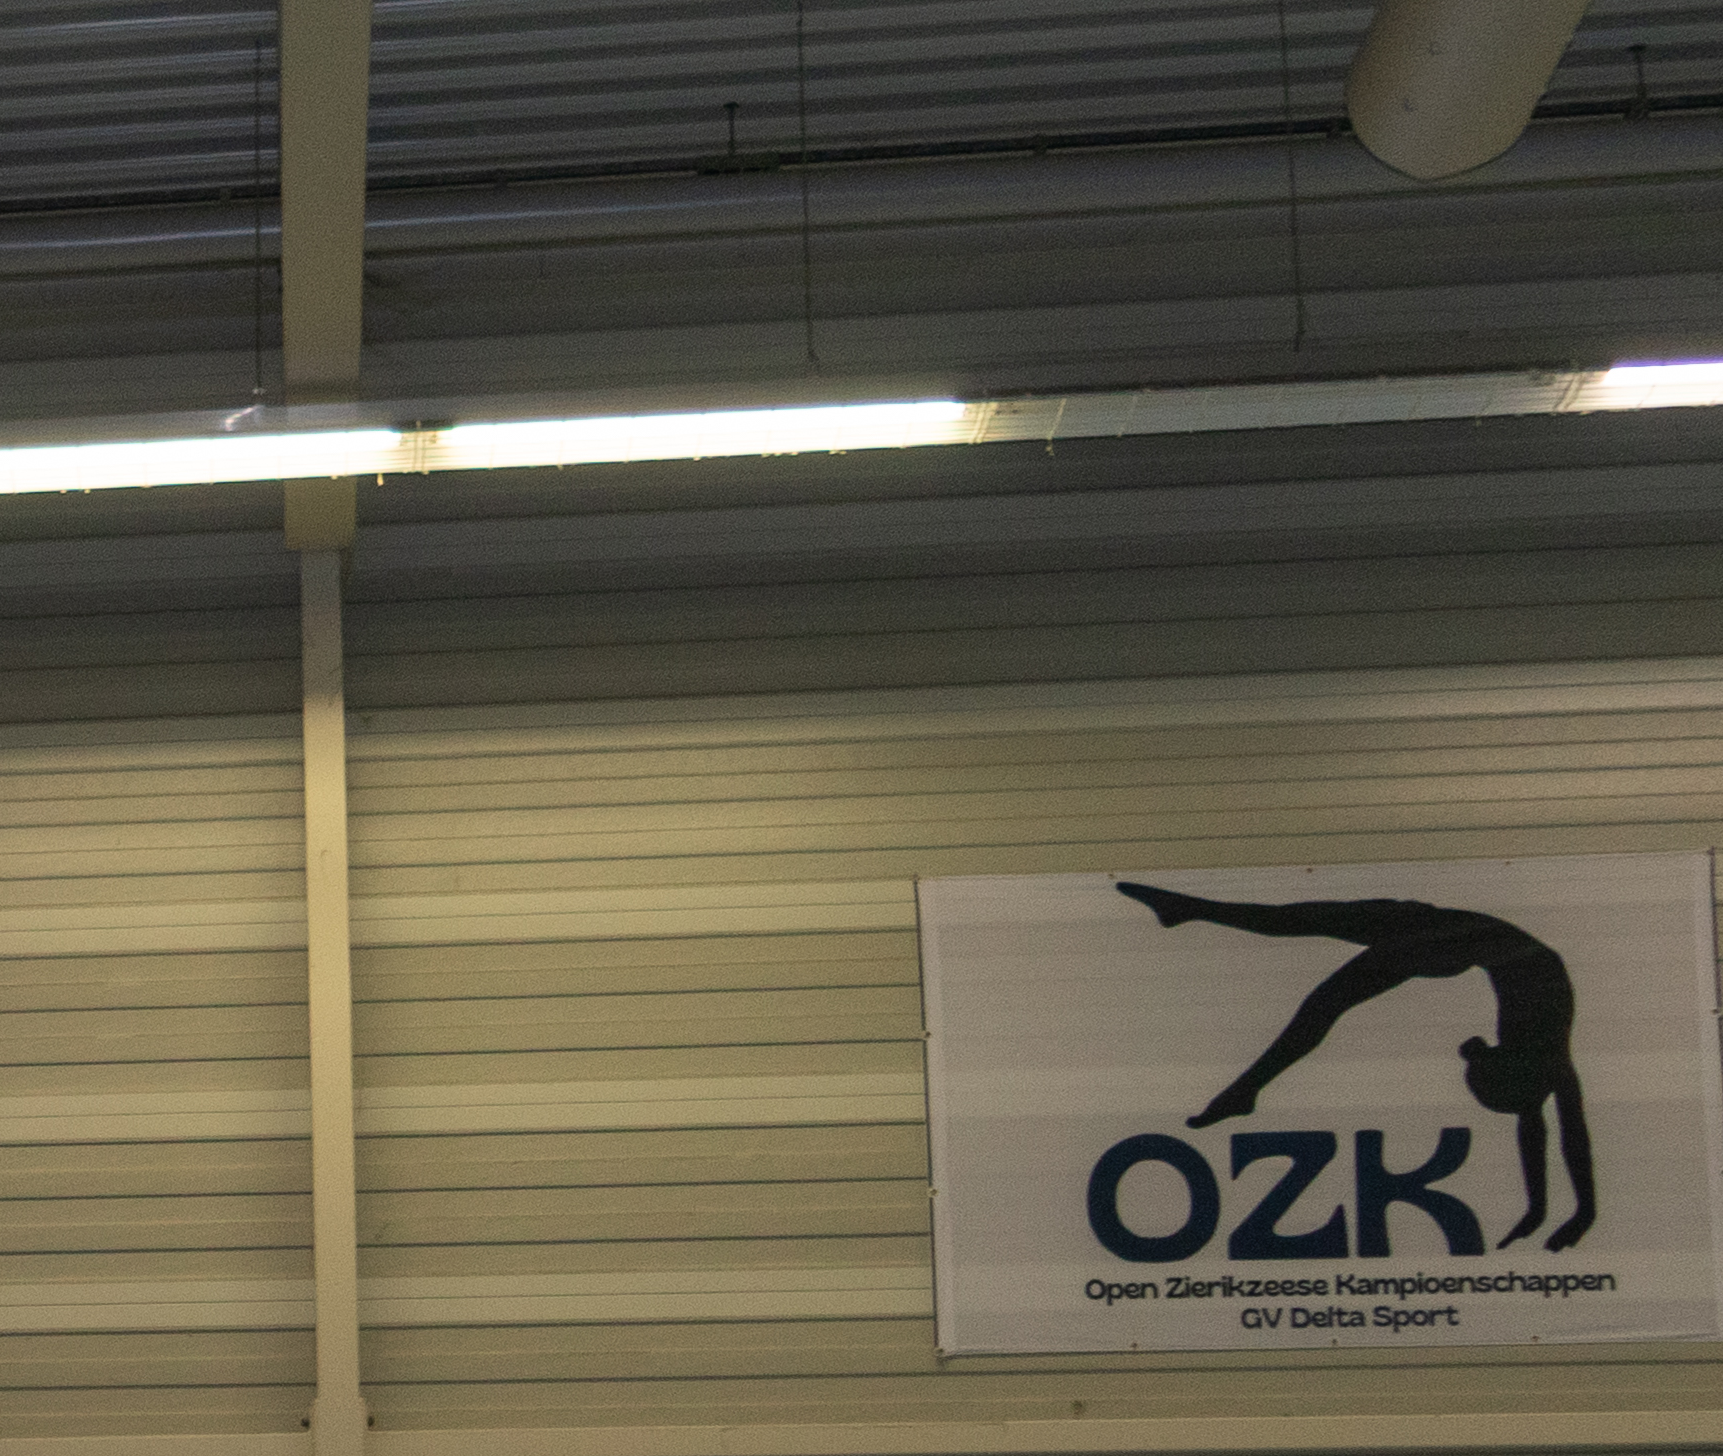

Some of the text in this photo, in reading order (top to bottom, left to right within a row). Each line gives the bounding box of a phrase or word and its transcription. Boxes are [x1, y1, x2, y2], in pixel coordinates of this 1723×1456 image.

[1086, 1126, 1485, 1263] OZK
[1084, 1271, 1616, 1306] Open Zierikzeese Kampioenschappen
[1241, 1305, 1459, 1333] GV Delta Sport
